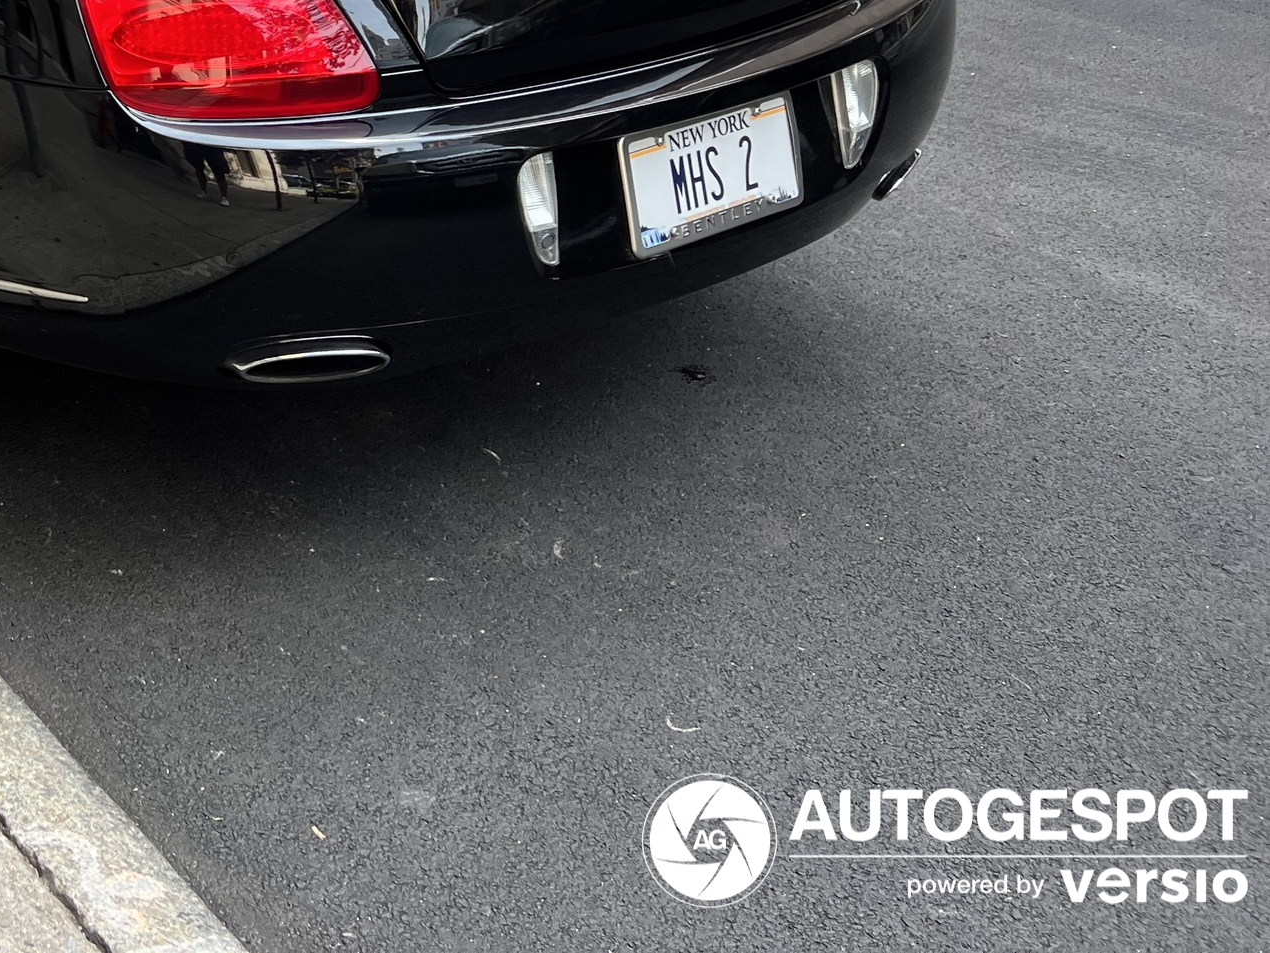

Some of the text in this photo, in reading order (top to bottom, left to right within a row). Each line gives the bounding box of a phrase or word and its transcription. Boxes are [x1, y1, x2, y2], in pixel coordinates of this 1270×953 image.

[668, 110, 750, 152] NEW YORK
[669, 135, 759, 214] MHS 2
[682, 198, 764, 238] BENTLEY
